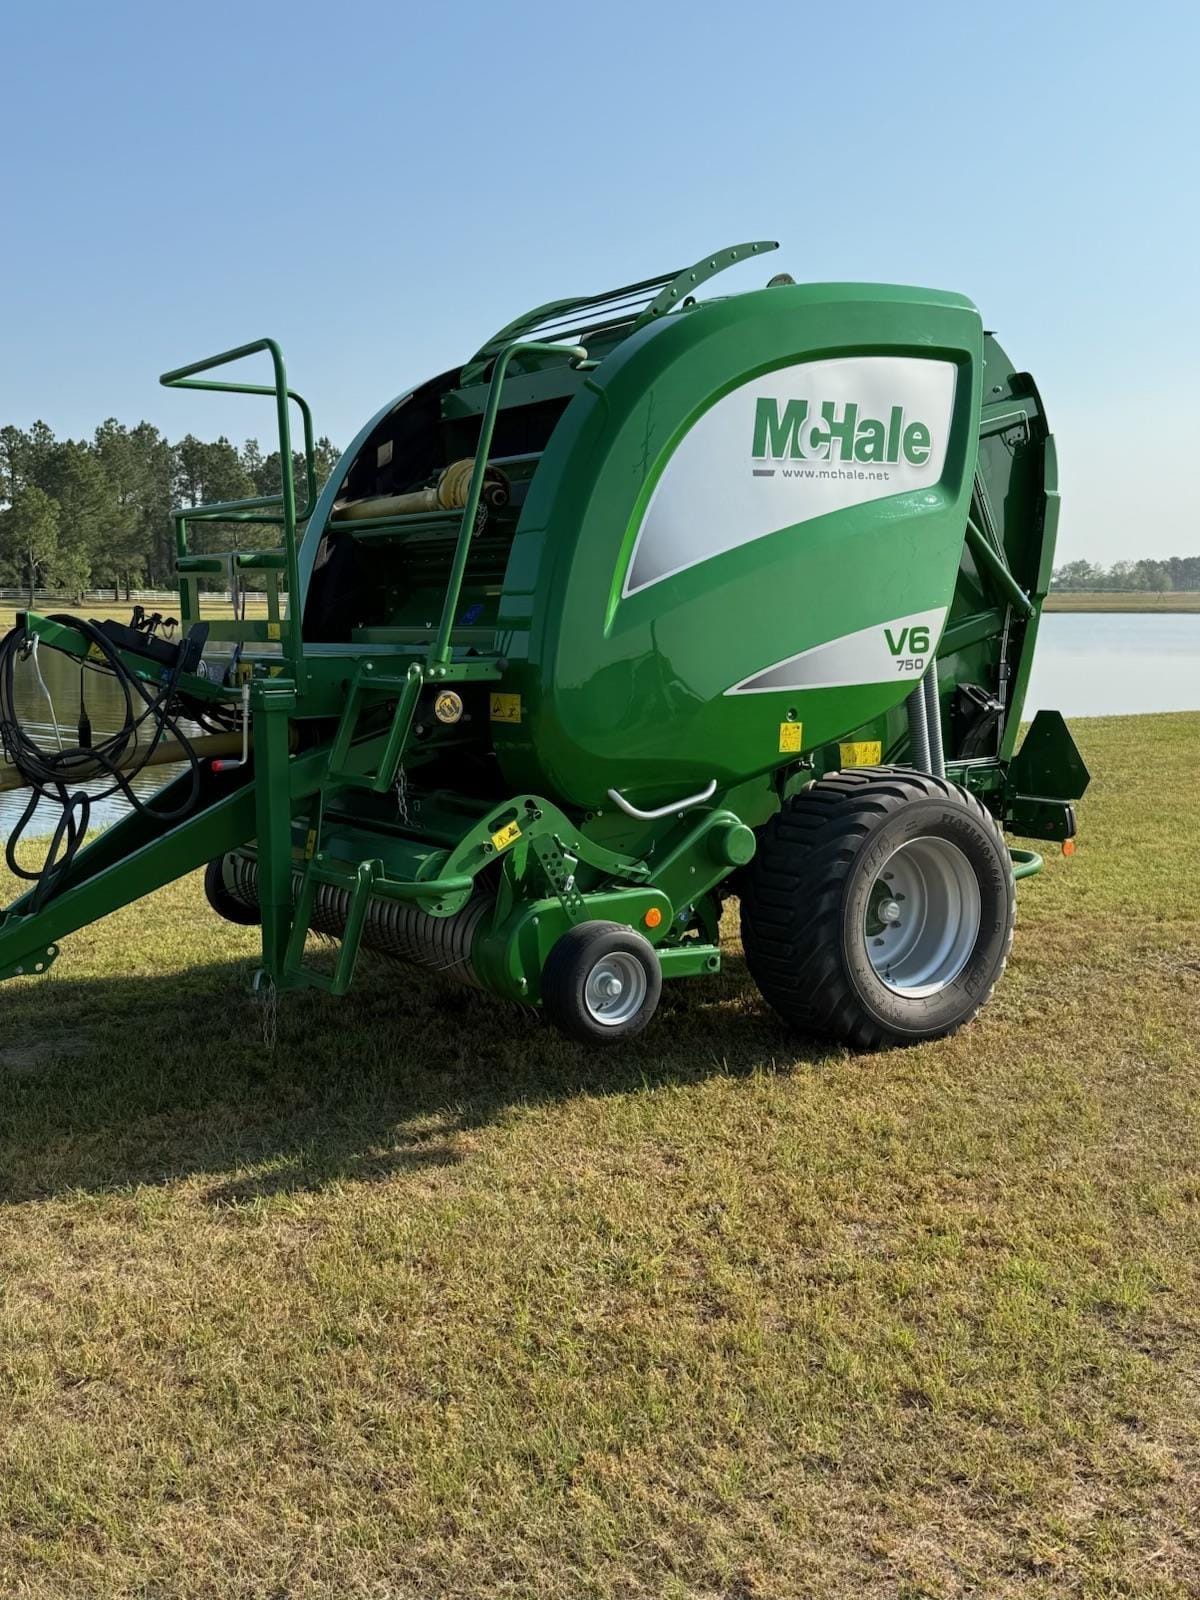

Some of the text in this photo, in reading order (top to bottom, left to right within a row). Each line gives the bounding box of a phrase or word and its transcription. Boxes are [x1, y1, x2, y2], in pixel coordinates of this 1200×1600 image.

[782, 468, 890, 481] www.mchale.net
[883, 626, 930, 656] V6
[896, 658, 924, 672] 750
